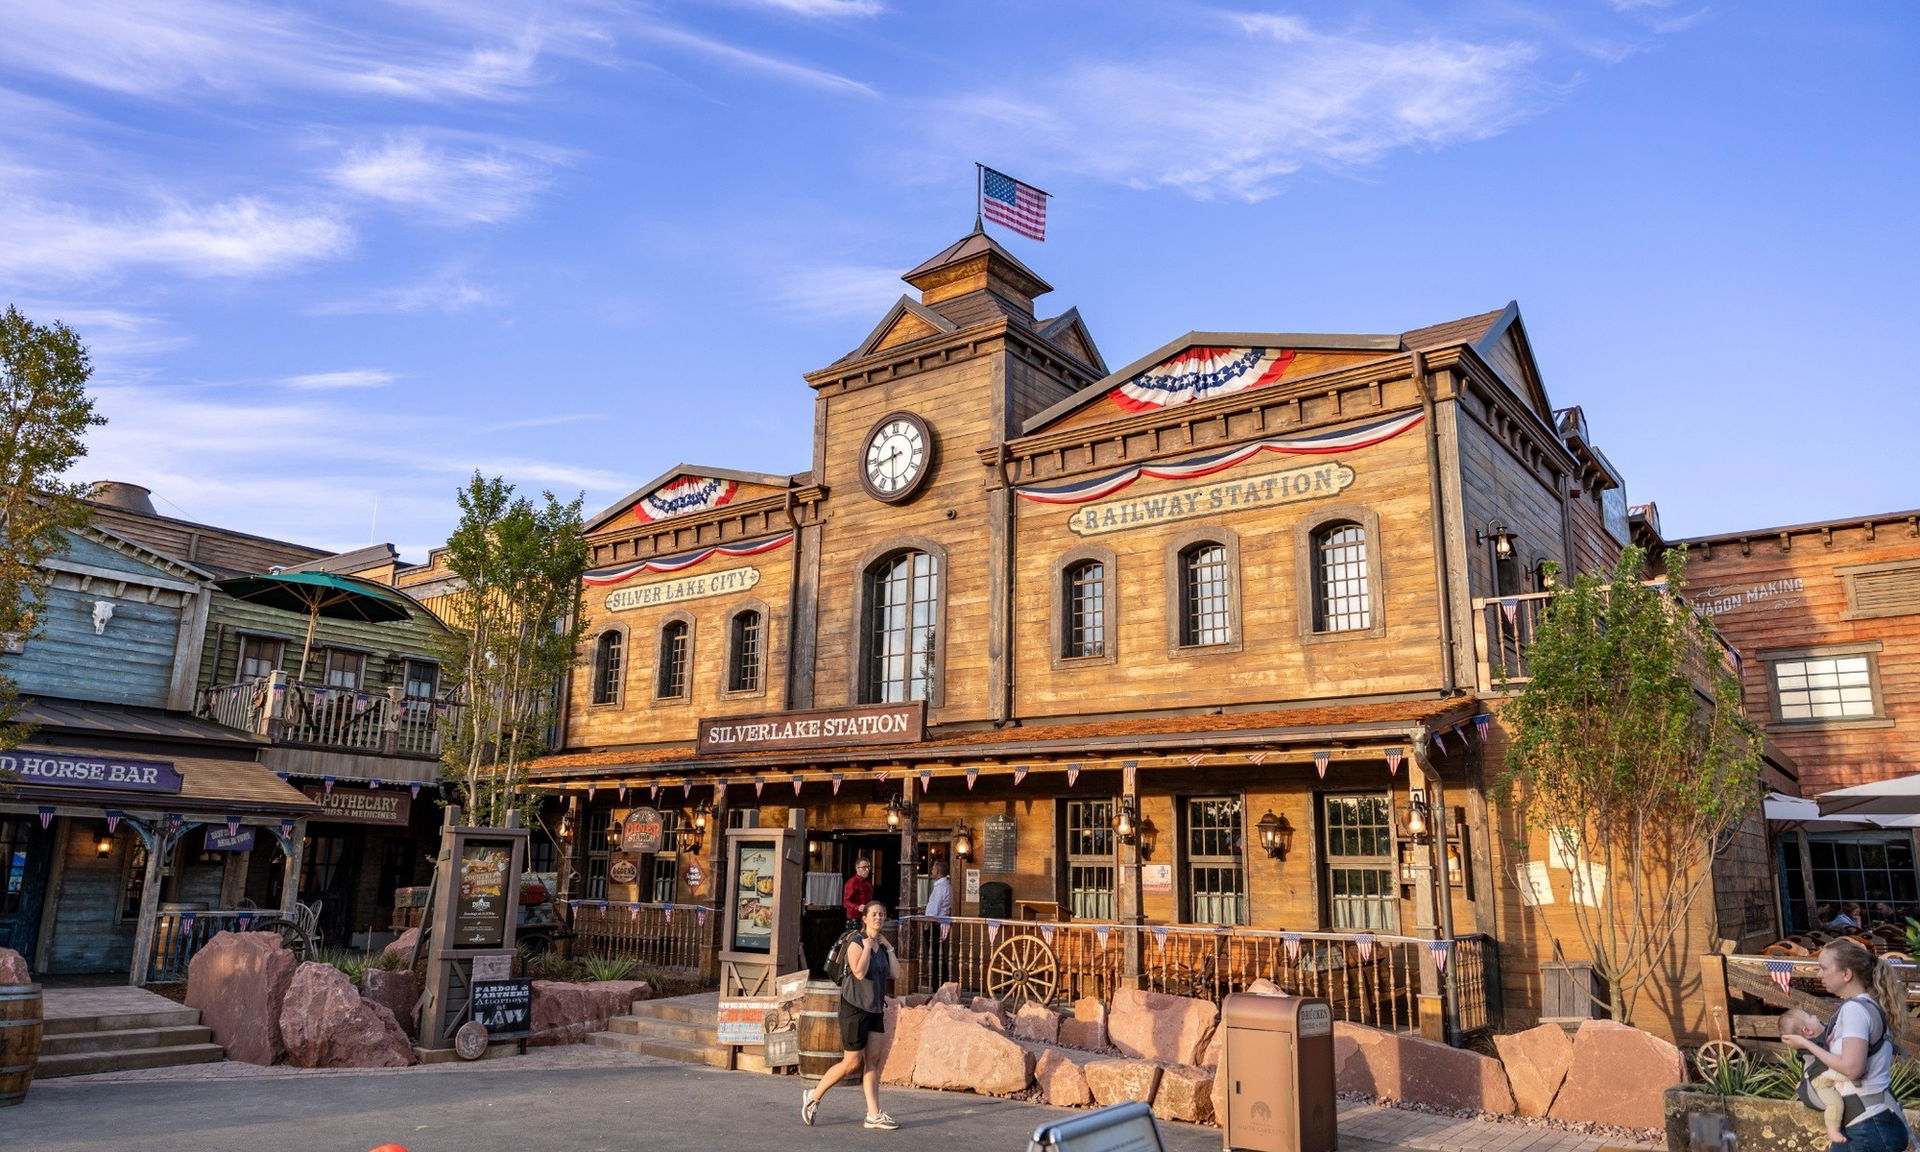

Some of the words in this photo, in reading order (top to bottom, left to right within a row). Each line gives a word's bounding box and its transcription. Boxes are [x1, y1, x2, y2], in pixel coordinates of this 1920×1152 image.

[1085, 492, 1200, 529] RAILWAY
[1209, 468, 1333, 510] STATION
[613, 586, 661, 608] SILVER
[665, 578, 706, 600] LAKE
[710, 570, 748, 592] CITY
[1746, 578, 1804, 603] MAKING
[708, 720, 820, 744] SILVERLAKE
[823, 713, 909, 737] STATION
[21, 758, 104, 780] HORSE
[108, 765, 158, 784] BAR
[314, 792, 399, 811] APOTHECARY
[351, 810, 397, 820] MEDICINES
[474, 985, 519, 993] PARDON
[474, 991, 529, 999] PARTNERS
[474, 997, 529, 1006] Attorneys
[474, 1009, 528, 1027] LAW
